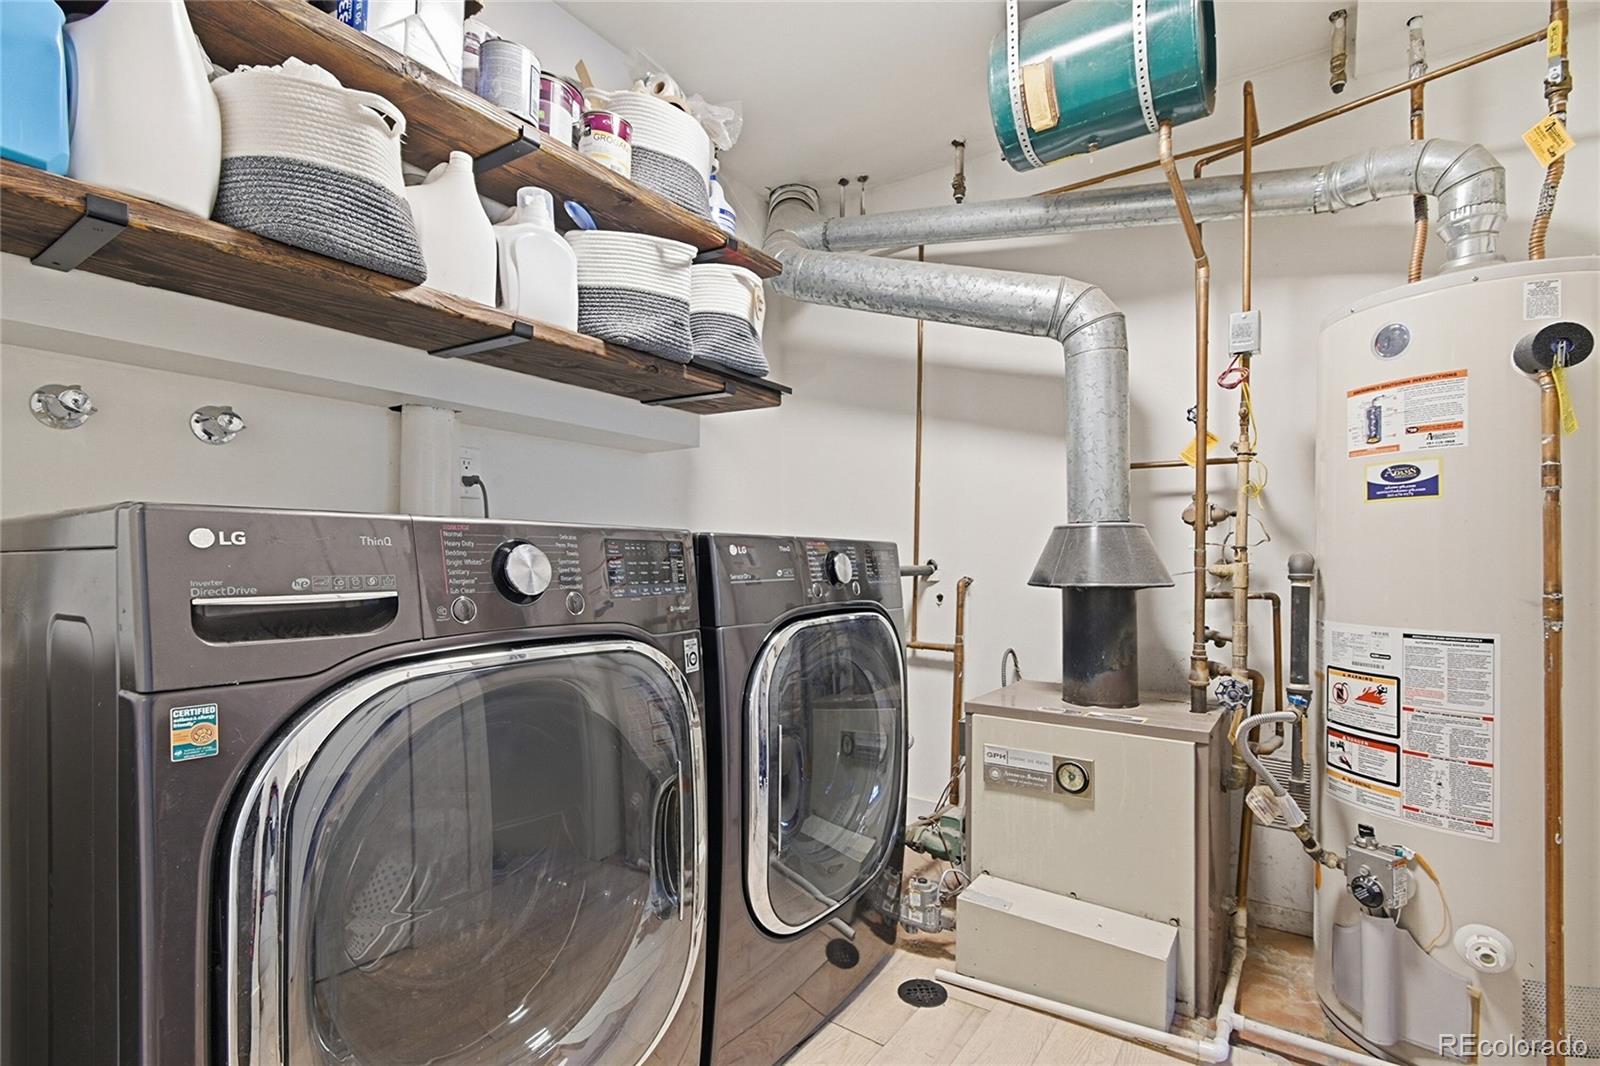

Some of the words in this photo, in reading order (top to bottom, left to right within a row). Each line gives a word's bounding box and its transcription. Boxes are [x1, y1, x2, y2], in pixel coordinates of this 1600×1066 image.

[218, 531, 246, 546] LG
[360, 536, 392, 546] ThinQ
[190, 586, 258, 598] DirectDrive
[172, 706, 216, 718] CERTIFIED
